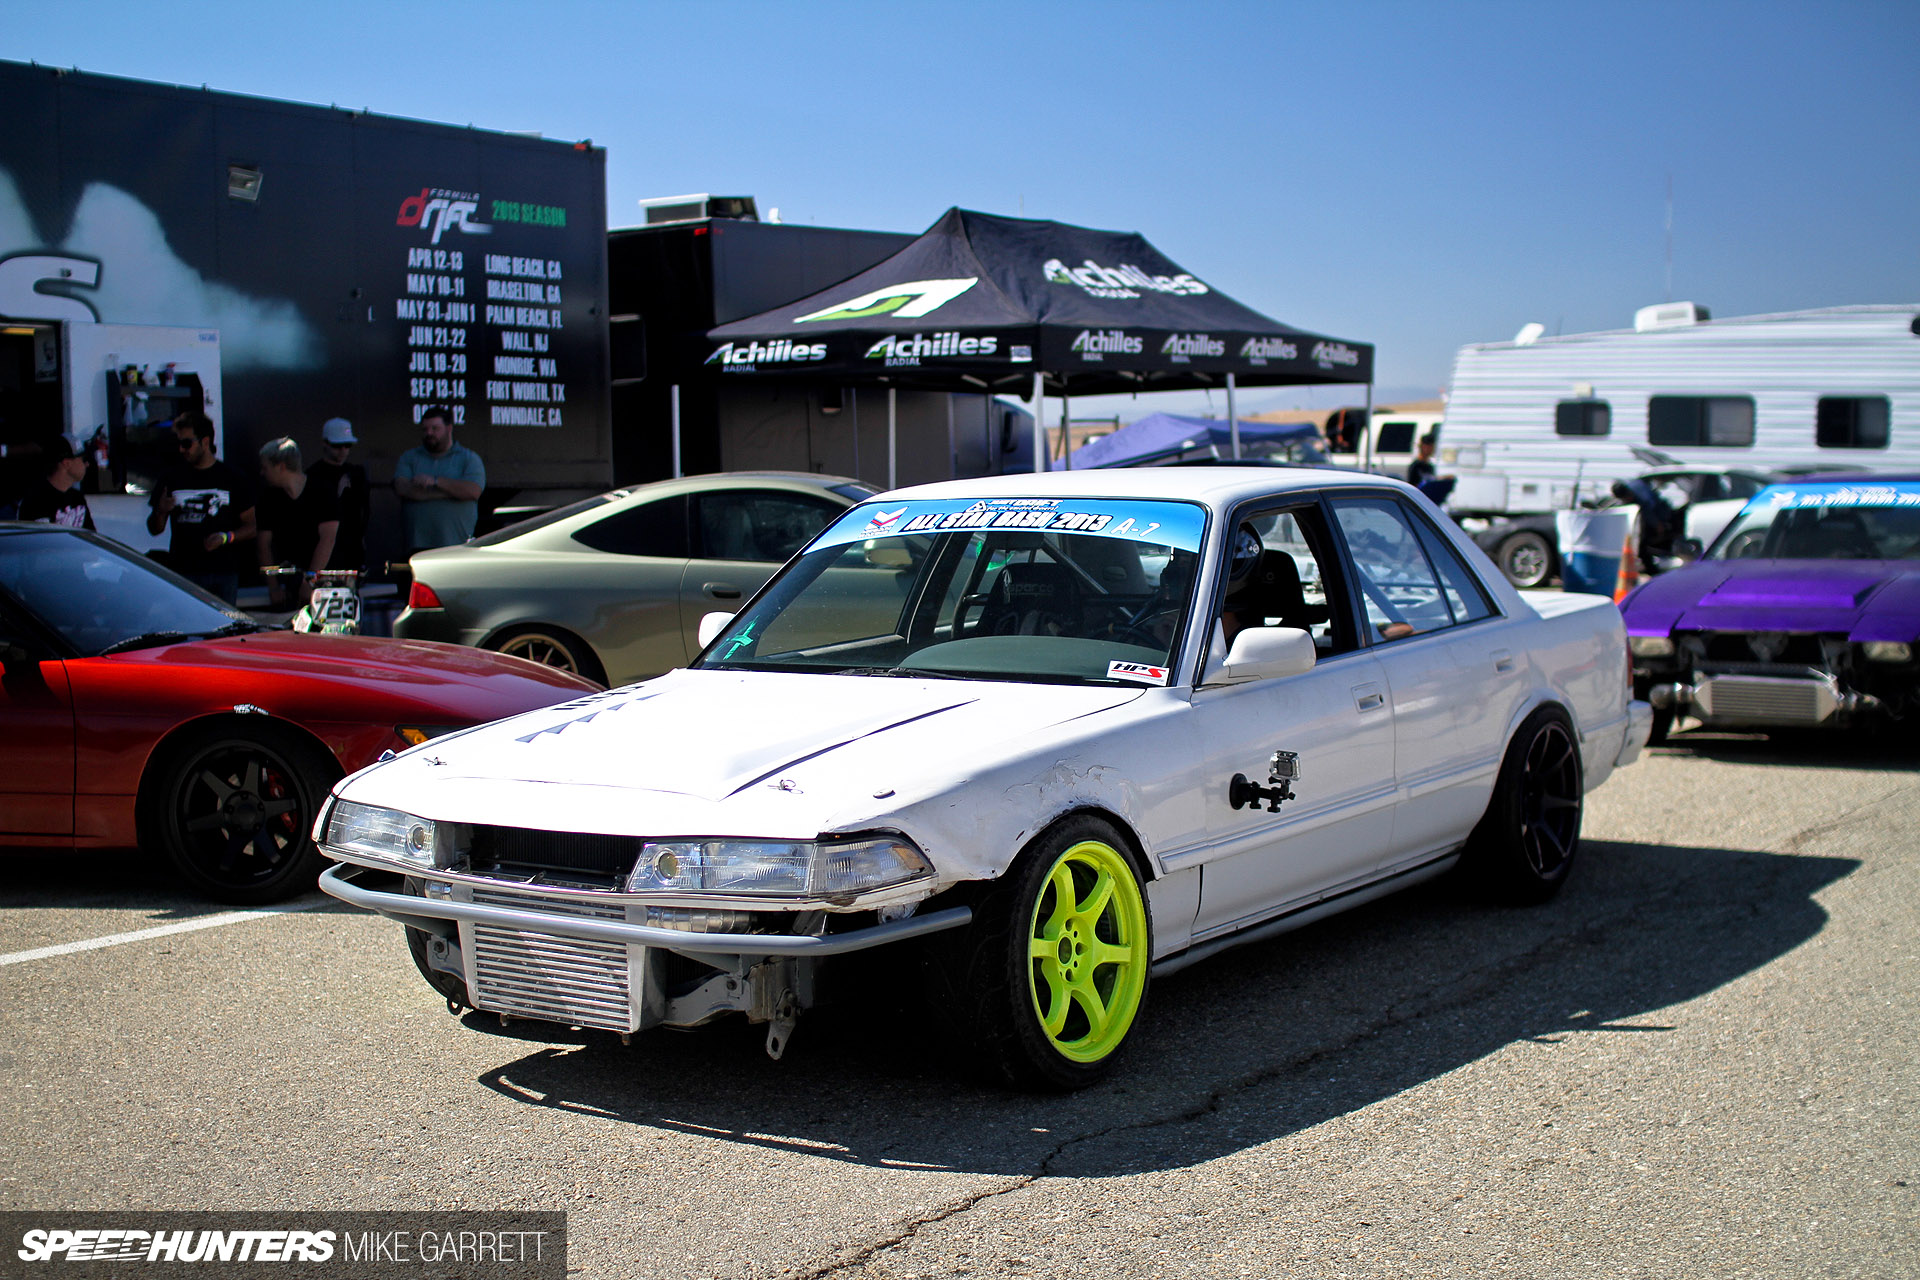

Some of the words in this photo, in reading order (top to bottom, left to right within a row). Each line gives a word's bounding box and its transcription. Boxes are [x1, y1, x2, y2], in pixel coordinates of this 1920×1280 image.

[429, 188, 480, 202] FORMULA
[492, 200, 521, 222] 2013
[521, 203, 567, 227] SEASON
[408, 247, 432, 269] APR
[433, 249, 463, 272] 12-13
[485, 254, 512, 275] LONG
[512, 257, 547, 279] BEACH,
[547, 261, 562, 280] CA
[407, 273, 436, 295] MAY
[437, 275, 465, 297] 10-11
[1042, 258, 1209, 295] Achilles
[397, 298, 425, 321] MAY
[469, 303, 476, 324] 1
[486, 305, 516, 327] PALM
[552, 310, 564, 329] FL
[408, 325, 433, 347] JUN
[434, 327, 467, 349] 21-22
[534, 333, 550, 352] NJ
[864, 331, 998, 359] Achilles
[1071, 329, 1144, 354] Achilles
[1160, 333, 1226, 357] Achilles
[1240, 337, 1298, 360] Achilles
[408, 351, 432, 373] JUL
[703, 339, 828, 365] Achilles
[885, 357, 922, 367] RADIAL
[1312, 341, 1359, 366] Achilles
[538, 358, 558, 378] WA
[722, 364, 757, 373] RADIAL
[410, 377, 434, 399] SEP
[435, 378, 467, 400] 13-14
[486, 380, 511, 401] FORT
[551, 383, 566, 403] TX
[547, 408, 563, 427] CA
[901, 514, 947, 532] ALL
[935, 511, 1000, 529] STAR
[986, 511, 1061, 529] BASH
[1045, 512, 1114, 532] 2013
[314, 597, 359, 620] 723
